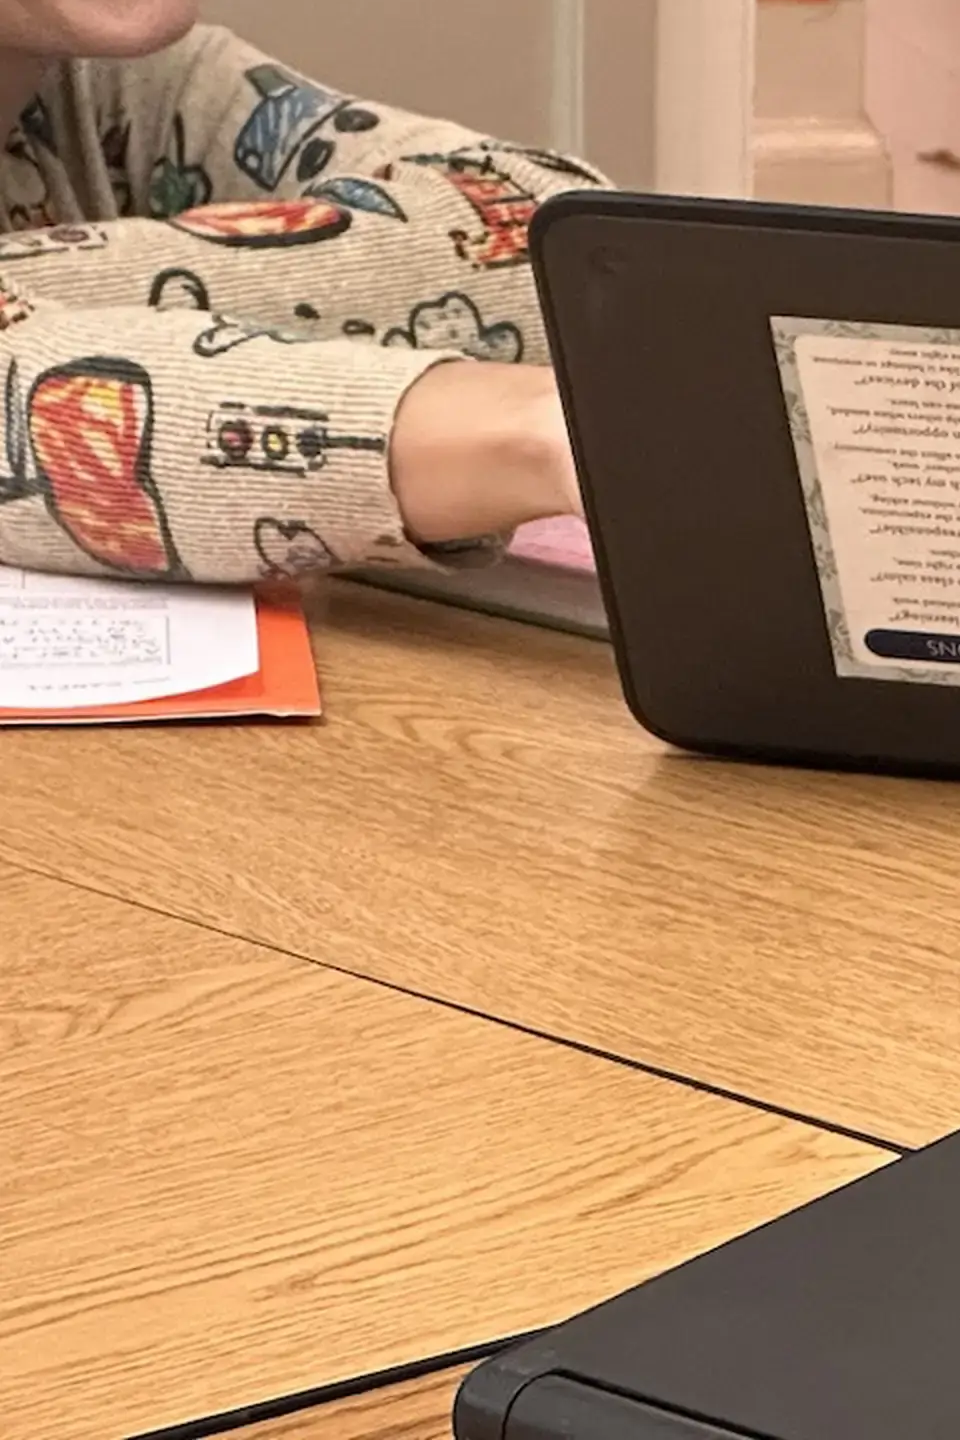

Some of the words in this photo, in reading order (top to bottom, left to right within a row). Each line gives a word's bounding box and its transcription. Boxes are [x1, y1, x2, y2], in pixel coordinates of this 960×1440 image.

[923, 378, 947, 392] the
[890, 475, 922, 488] tech
[923, 475, 947, 488] my
[919, 574, 955, 588] class
